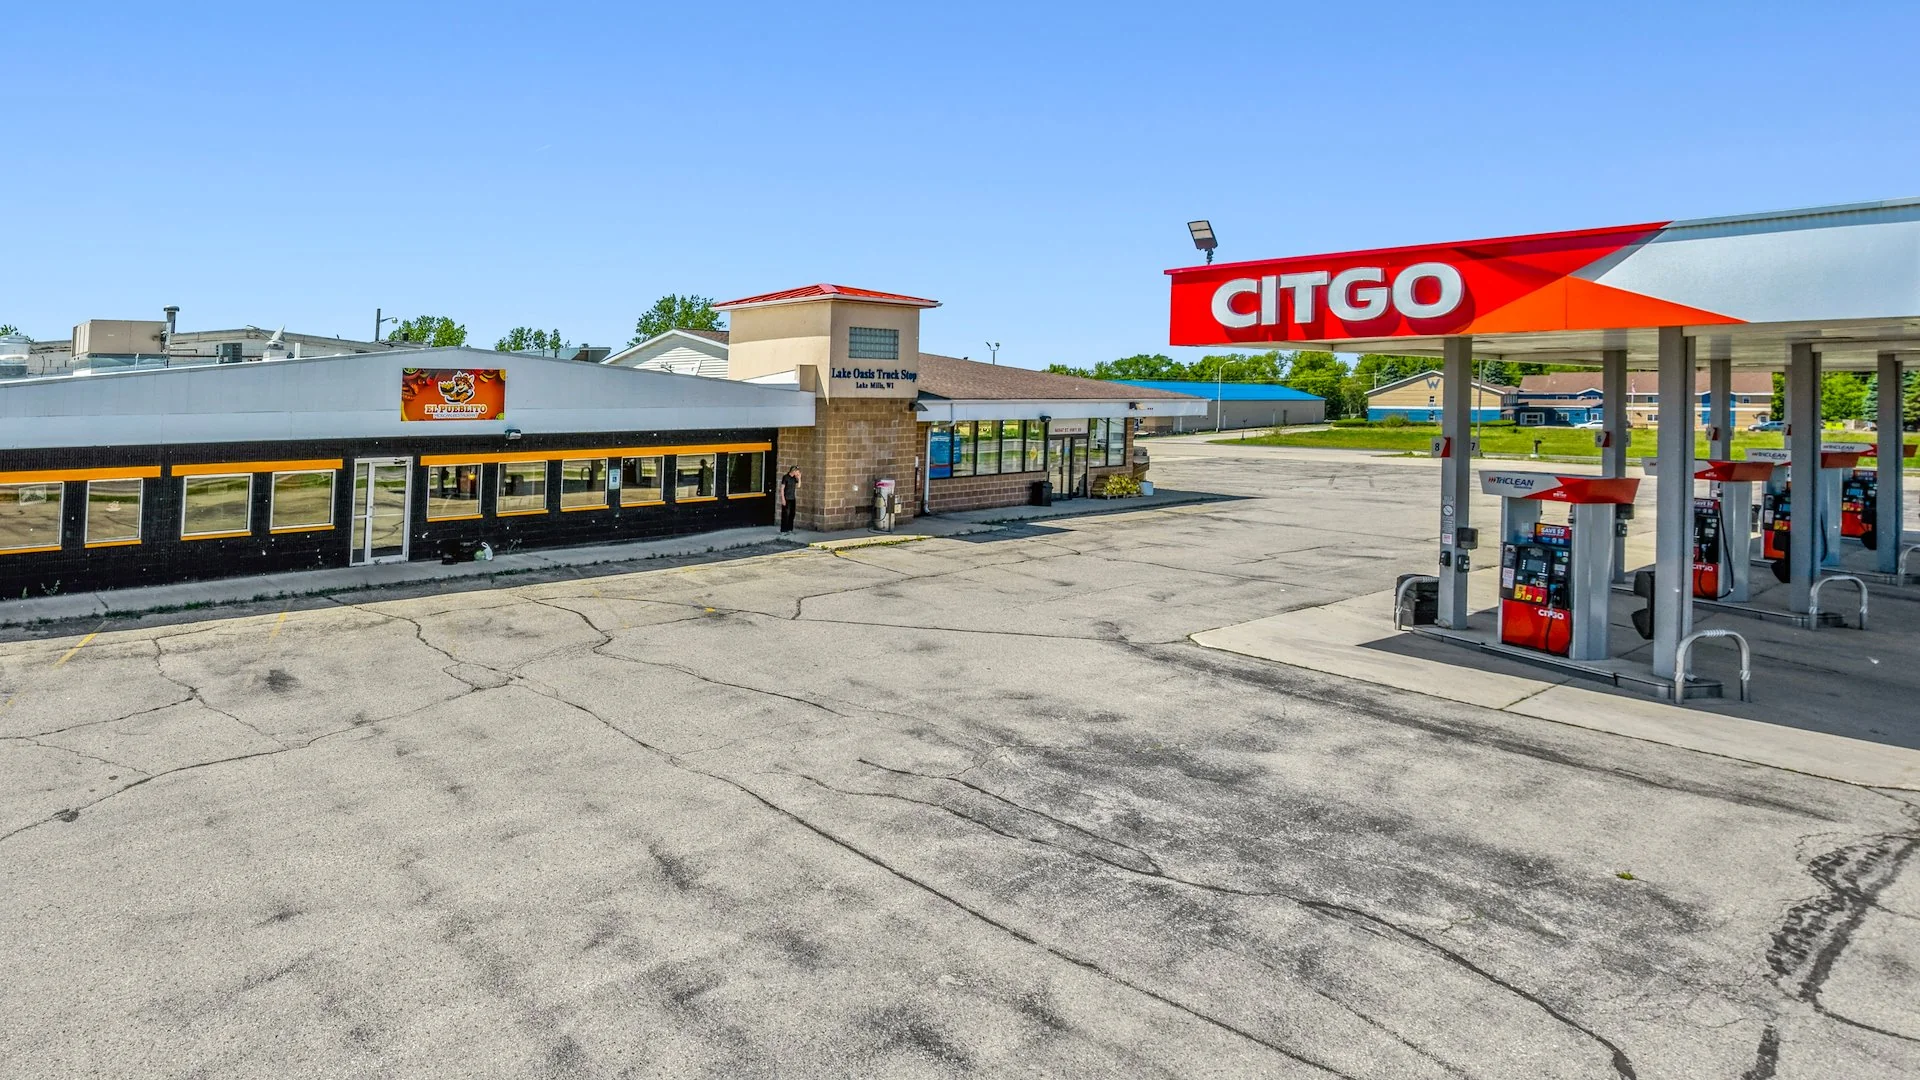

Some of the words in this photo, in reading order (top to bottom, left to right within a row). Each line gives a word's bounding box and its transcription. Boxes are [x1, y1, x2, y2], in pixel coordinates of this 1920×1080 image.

[1210, 261, 1466, 330] CITGO
[831, 368, 851, 378] Lake
[853, 368, 875, 379] Oasis
[876, 368, 899, 380] Truck
[900, 369, 917, 383] Stop
[1426, 377, 1441, 391] W
[426, 404, 438, 414] EL
[439, 404, 487, 414] PUEBLITO
[1434, 442, 1440, 451] 8
[1471, 442, 1477, 451] 7
[1495, 476, 1535, 487] TriCLEAN
